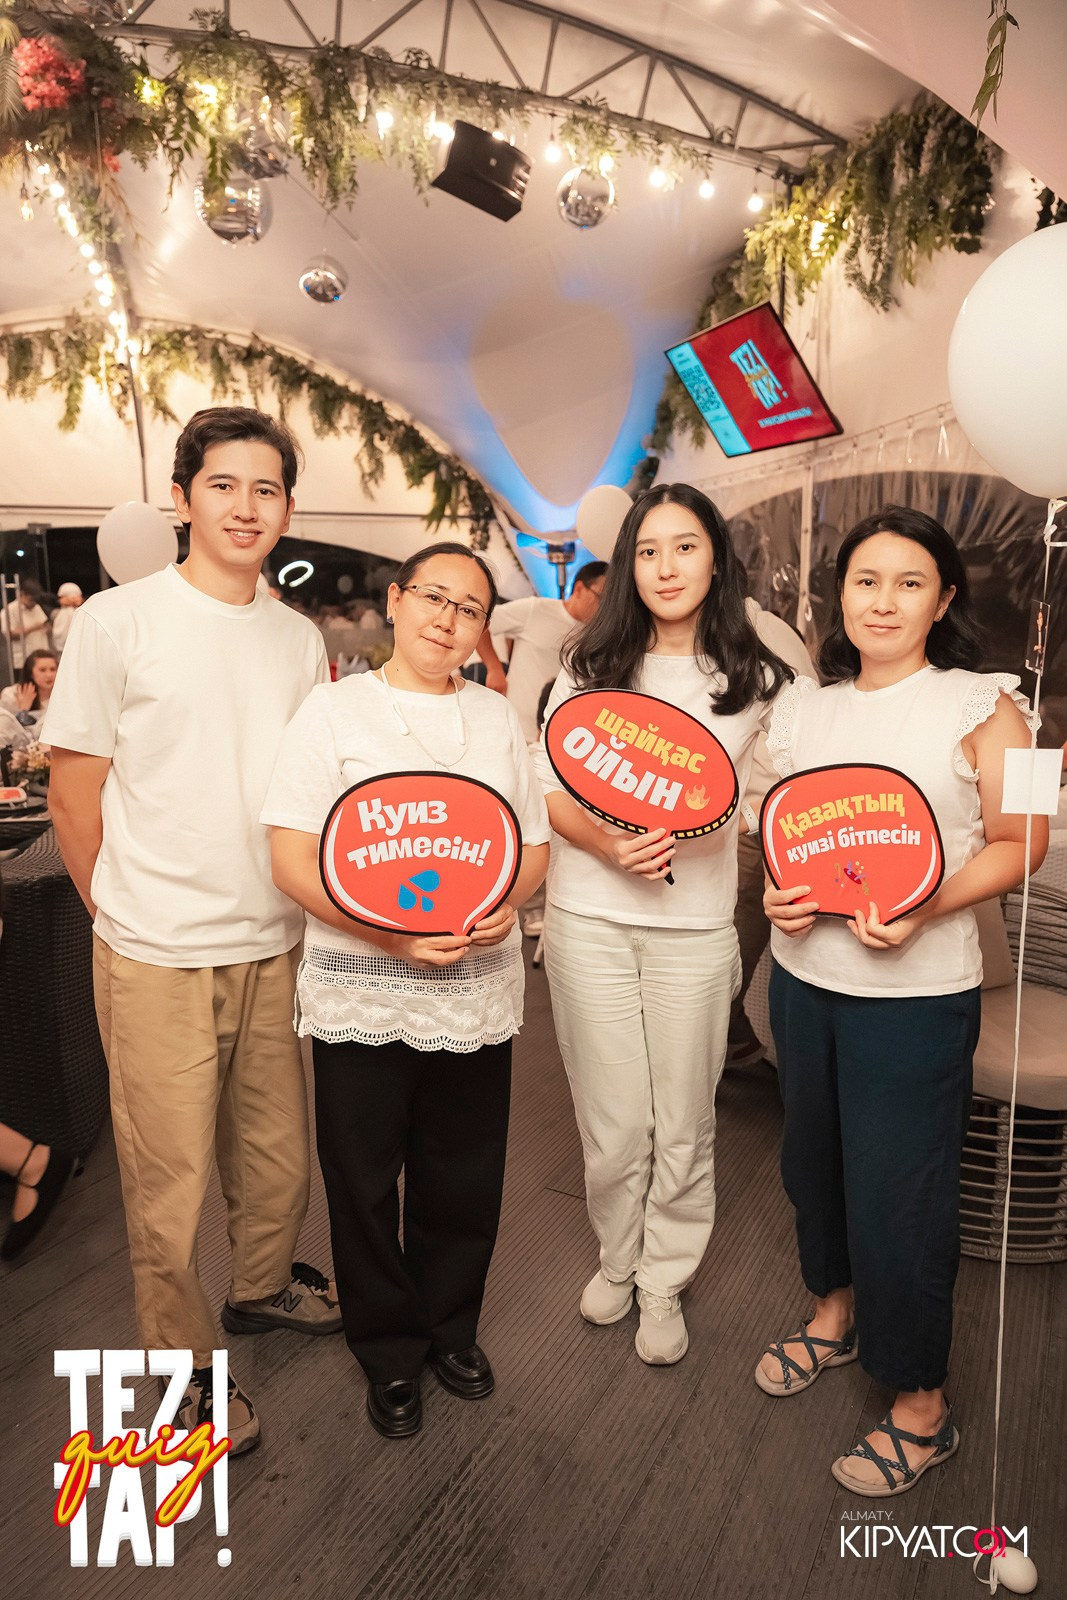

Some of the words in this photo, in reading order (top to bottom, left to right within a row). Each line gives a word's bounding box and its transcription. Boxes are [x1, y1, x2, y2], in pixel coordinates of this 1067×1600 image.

[594, 707, 706, 774] шайқас
[357, 797, 448, 836] Куиз
[778, 793, 905, 840] Қазақтың
[346, 835, 491, 870] тимесін!
[785, 830, 836, 864] куизі
[837, 823, 921, 848] бітпесін
